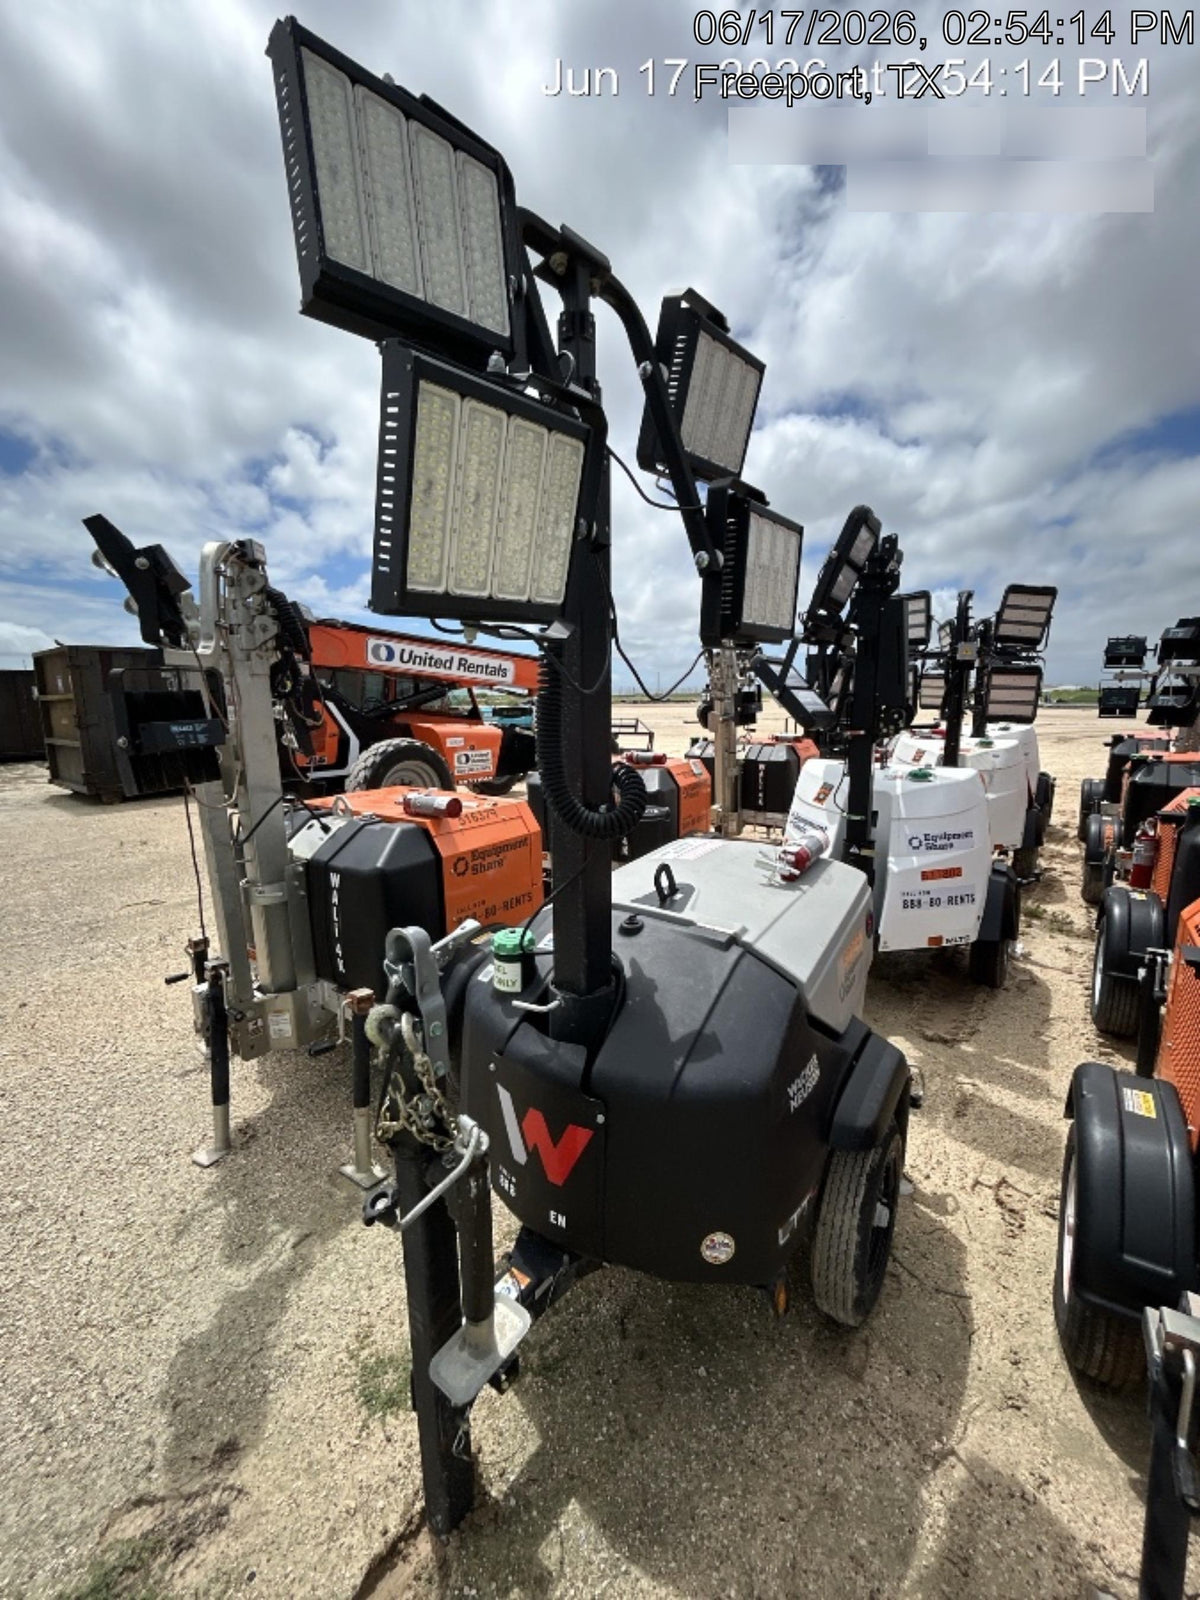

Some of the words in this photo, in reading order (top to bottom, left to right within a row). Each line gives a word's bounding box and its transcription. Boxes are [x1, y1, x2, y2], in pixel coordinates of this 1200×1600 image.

[399, 648, 453, 671] United
[456, 657, 508, 679] Rentals
[470, 836, 530, 861] Equipment
[470, 858, 505, 876] Share
